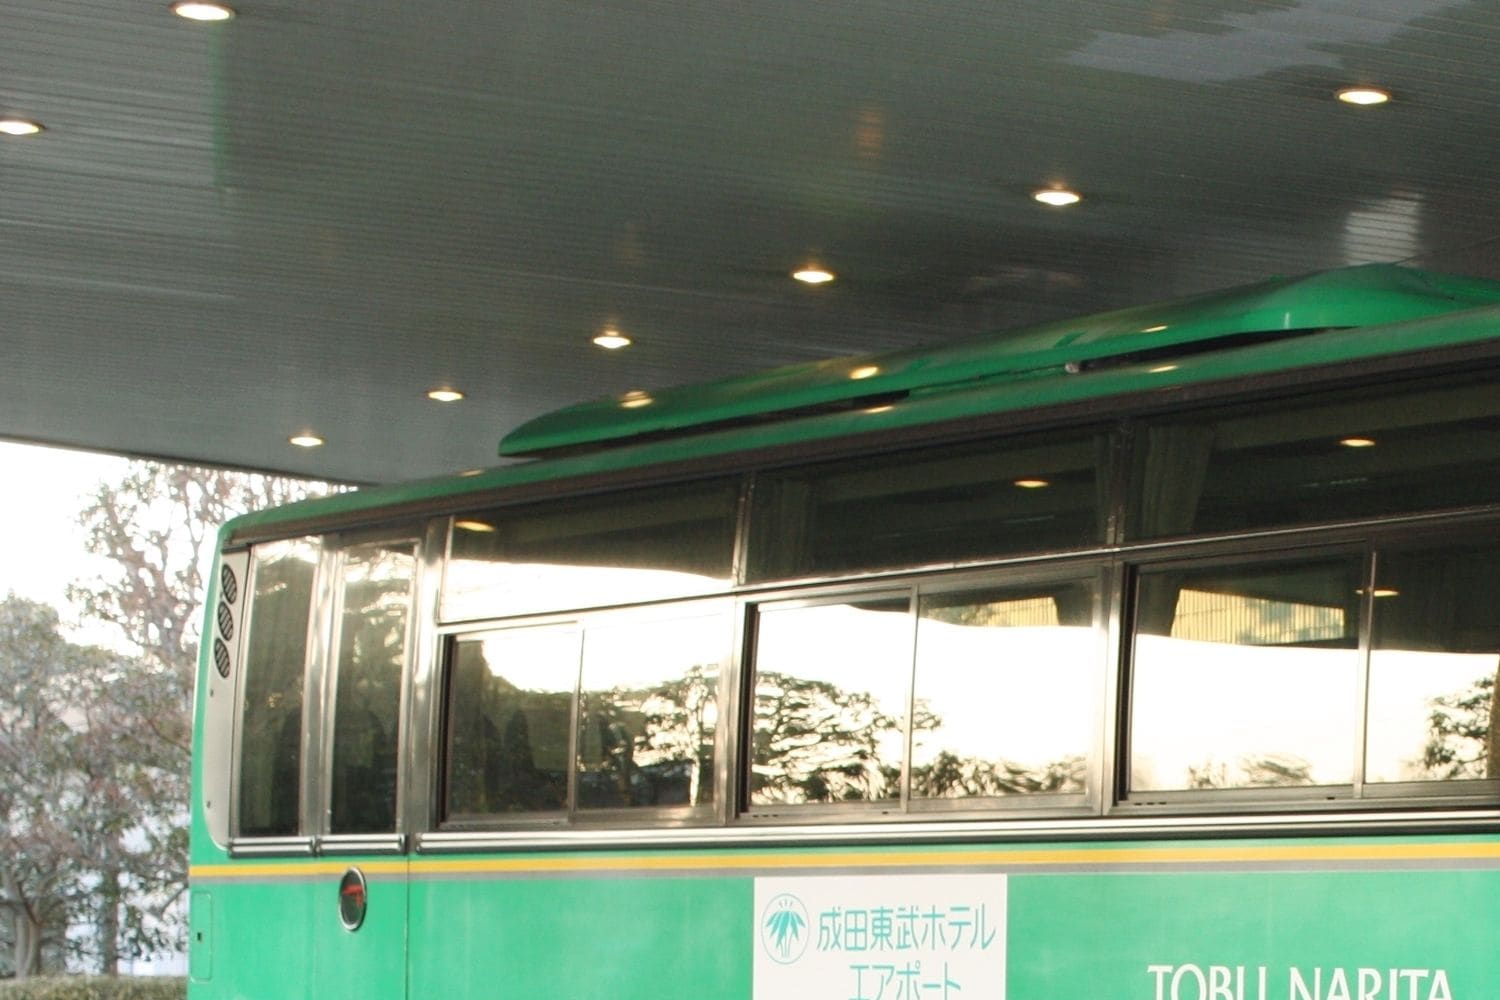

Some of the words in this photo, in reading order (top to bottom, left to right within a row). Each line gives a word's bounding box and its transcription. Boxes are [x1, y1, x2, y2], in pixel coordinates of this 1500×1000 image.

[816, 903, 997, 951] 成田東武ホテル
